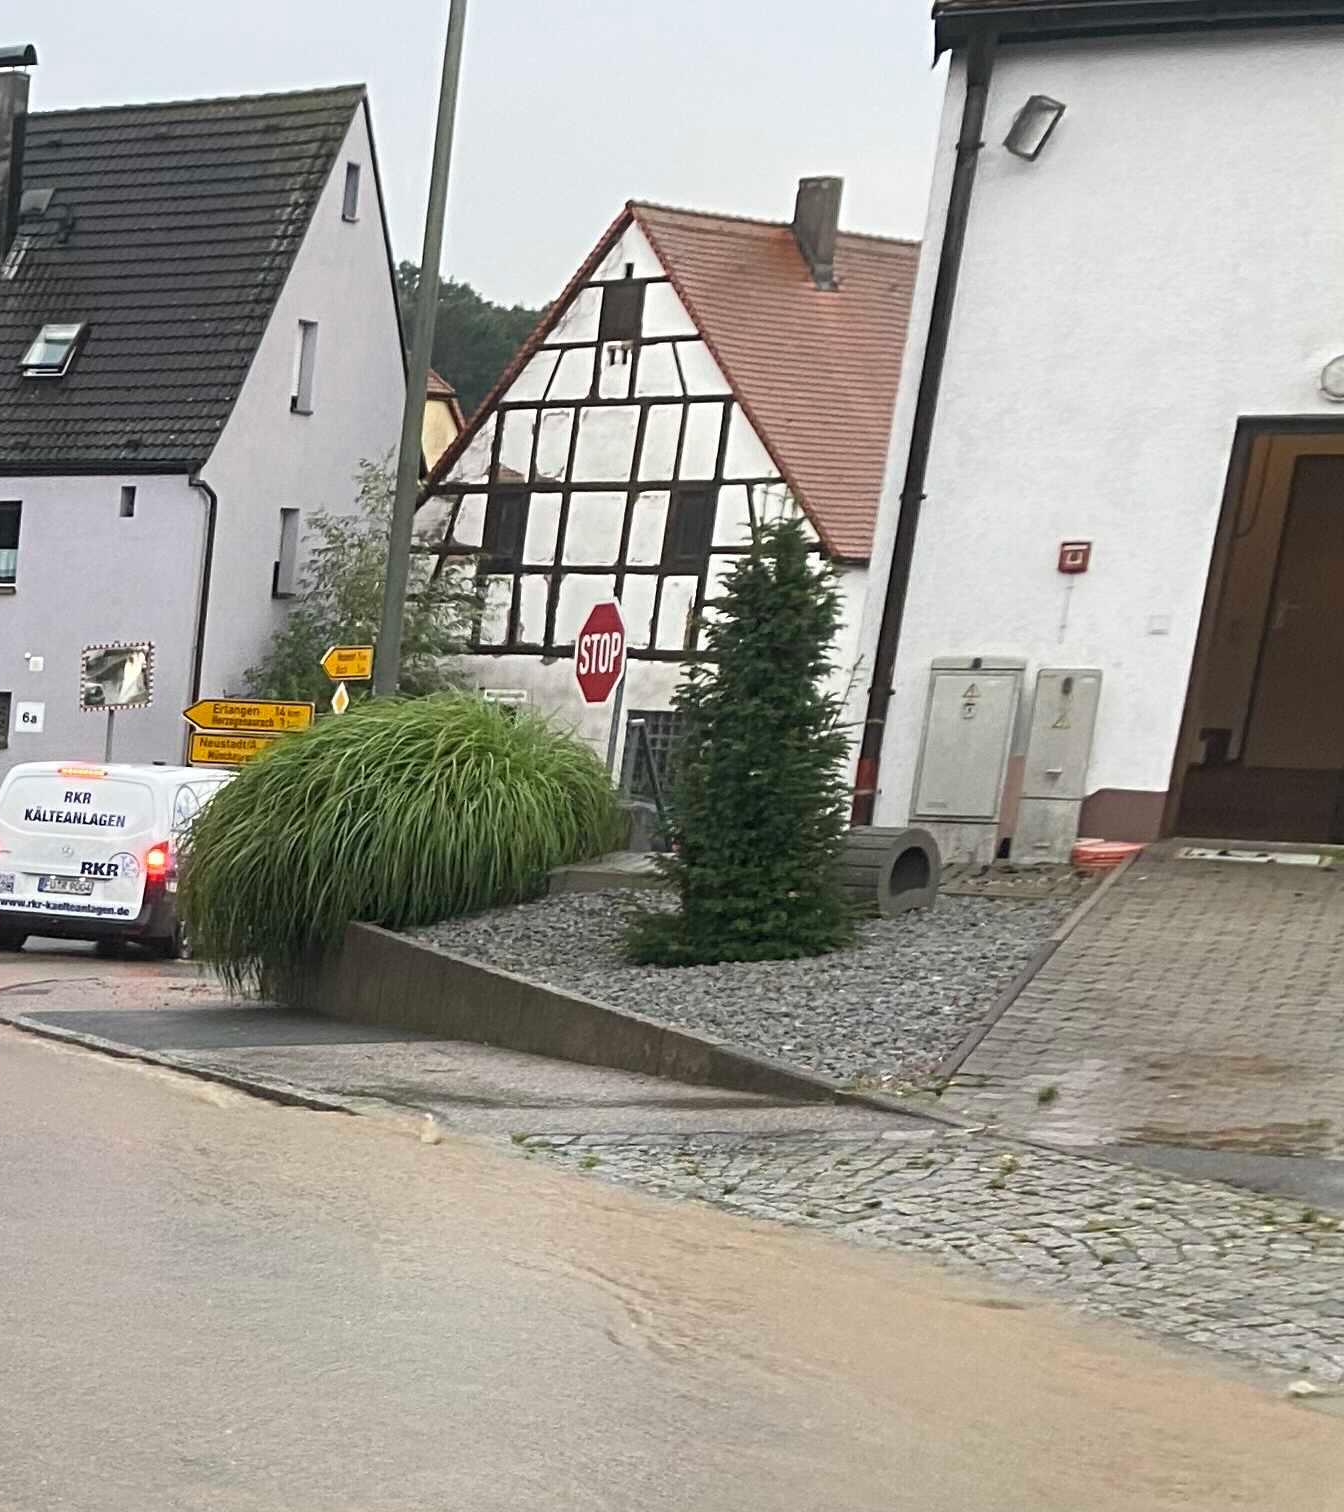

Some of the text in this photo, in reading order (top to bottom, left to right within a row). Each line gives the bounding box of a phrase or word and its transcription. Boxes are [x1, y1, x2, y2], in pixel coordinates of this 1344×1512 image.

[579, 632, 622, 675] STOP
[23, 711, 37, 724] 6a
[213, 704, 260, 717] Erlangen
[64, 791, 92, 804] RKR
[24, 807, 126, 828] KÄLTEANLAGEN
[80, 861, 119, 877] RKR
